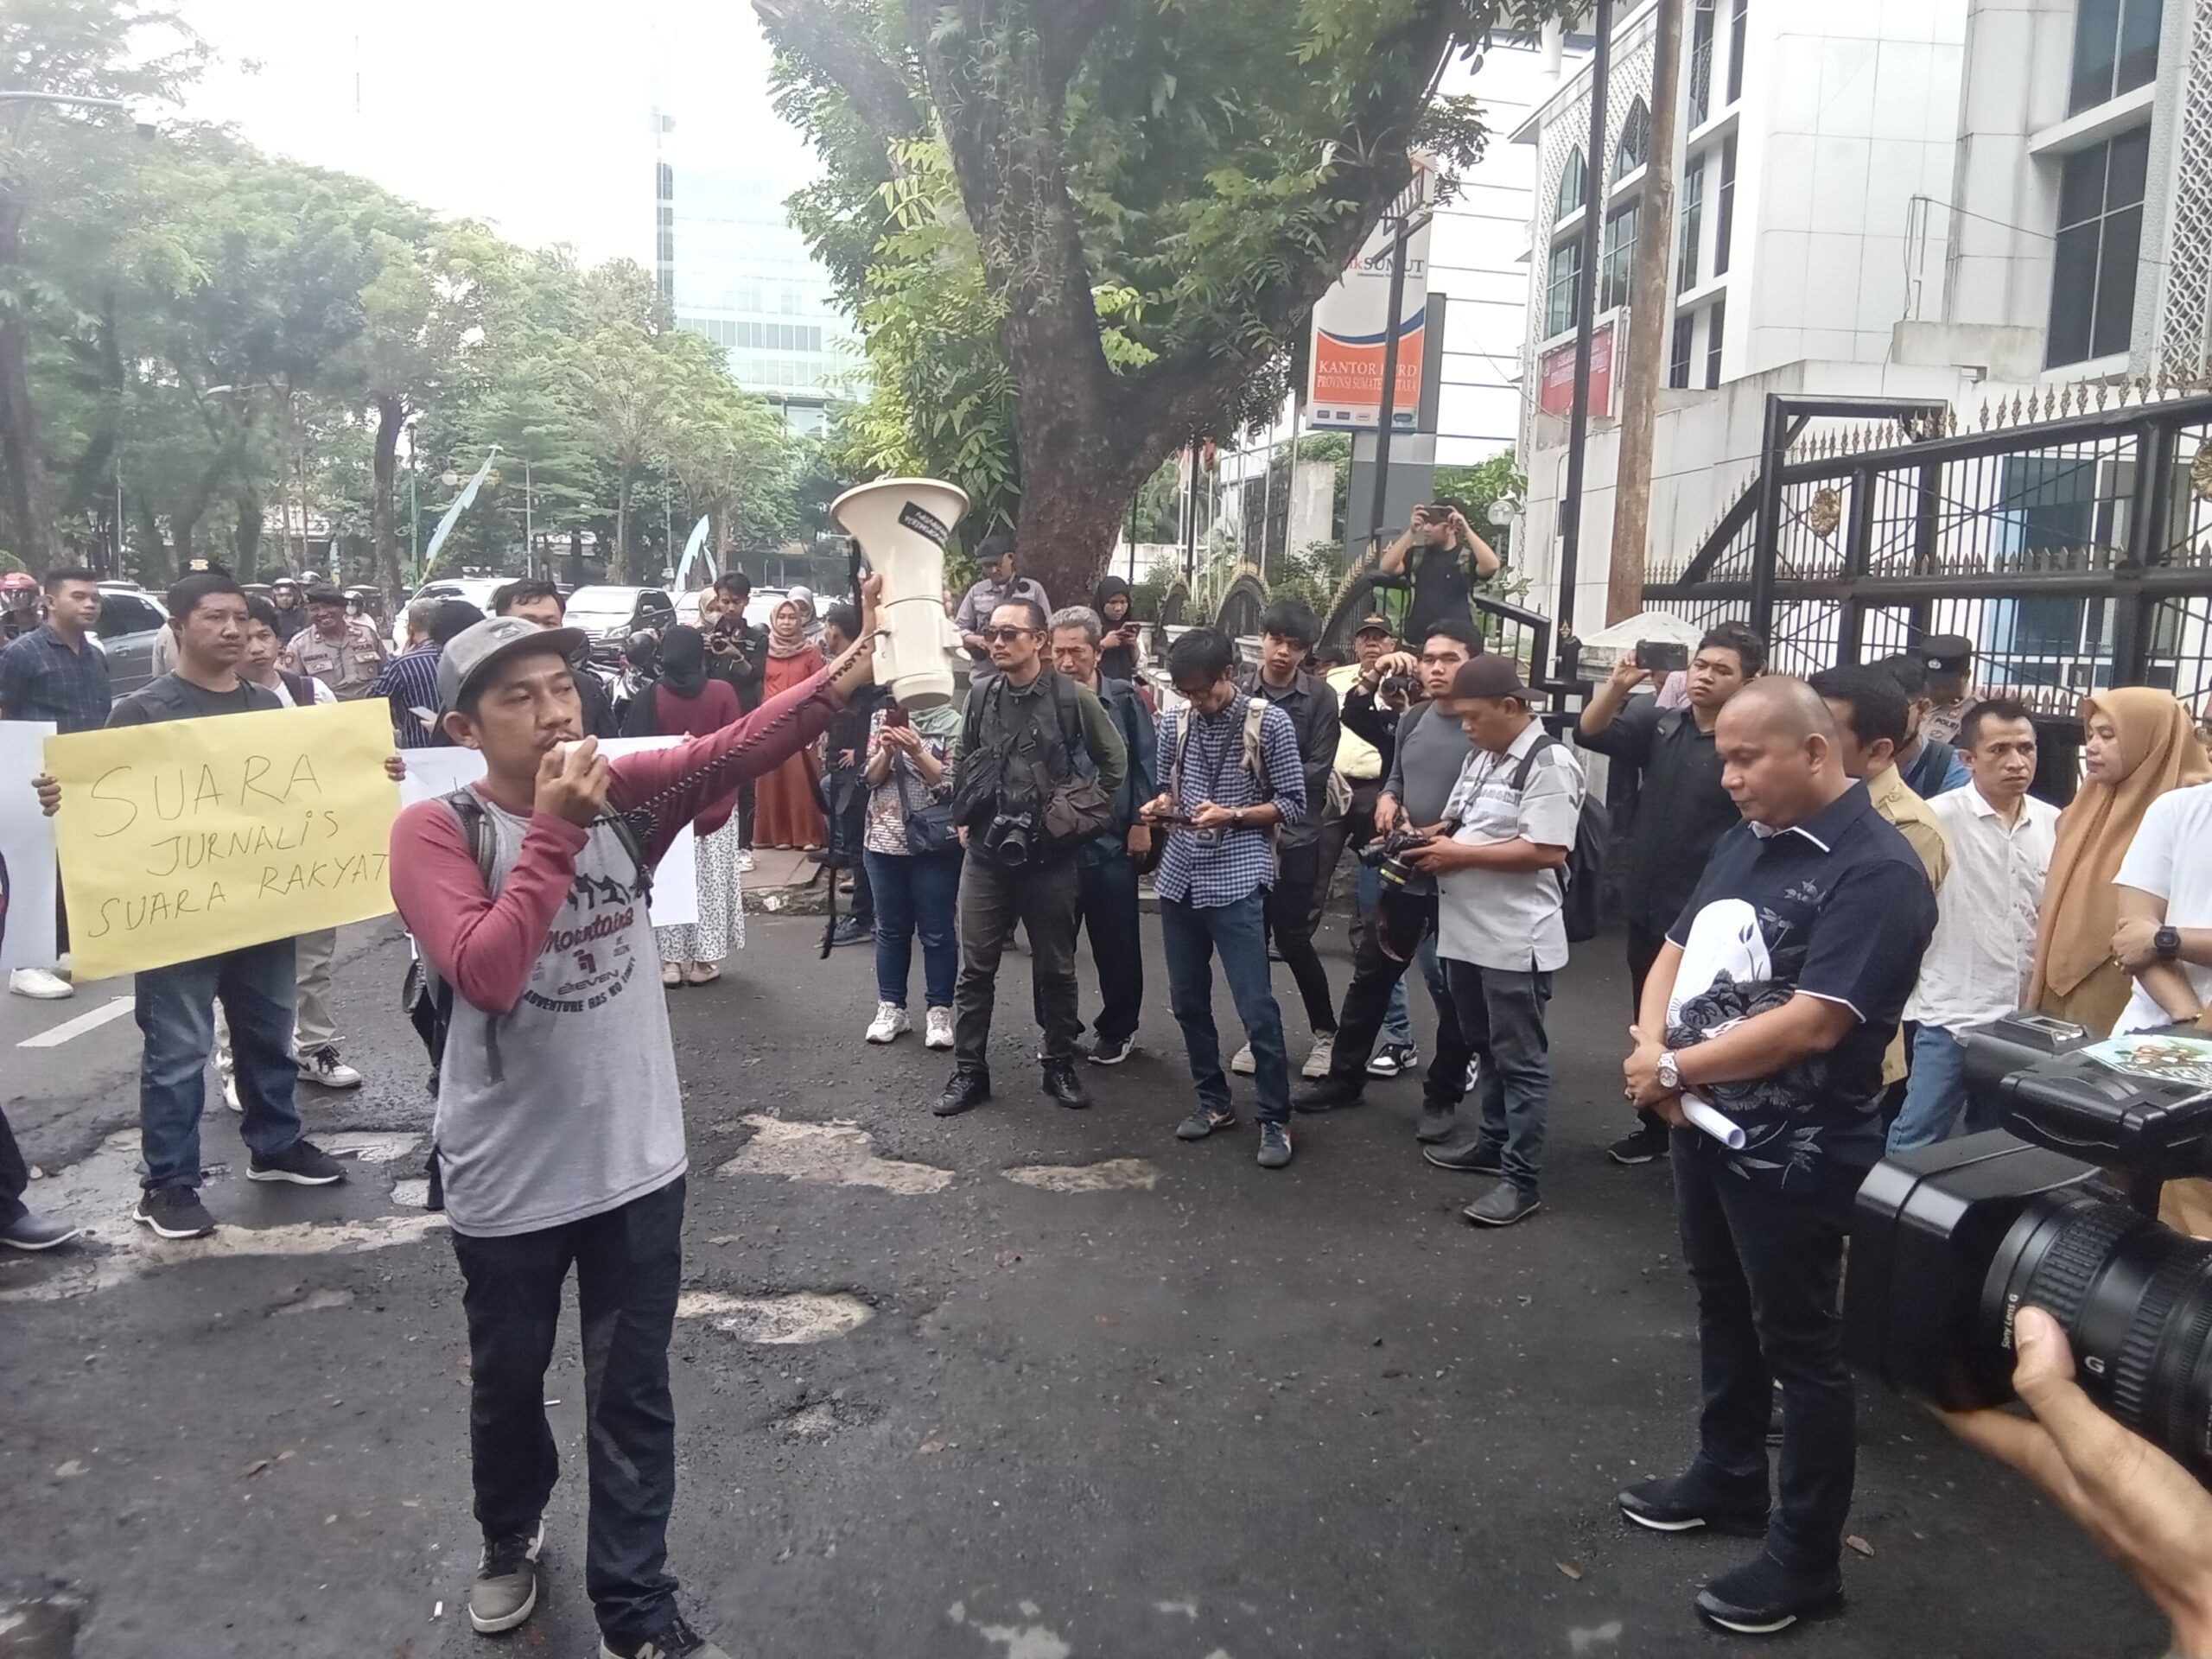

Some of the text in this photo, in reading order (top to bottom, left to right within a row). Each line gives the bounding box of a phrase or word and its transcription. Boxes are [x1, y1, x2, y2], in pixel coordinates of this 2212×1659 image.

[1317, 375, 1351, 389] PROVINSI
[1352, 377, 1383, 391] SUMATE
[1319, 360, 1417, 377] KANTOR RD
[1935, 717, 1959, 730] POLRI
[91, 753, 322, 837] SUARA
[89, 854, 390, 938] SUARA RAKYAT
[524, 957, 636, 1013] ADVENTURE HAS NO LIMIT
[2000, 1293, 2019, 1350] Sony Lens G
[2084, 1356, 2105, 1374] G
